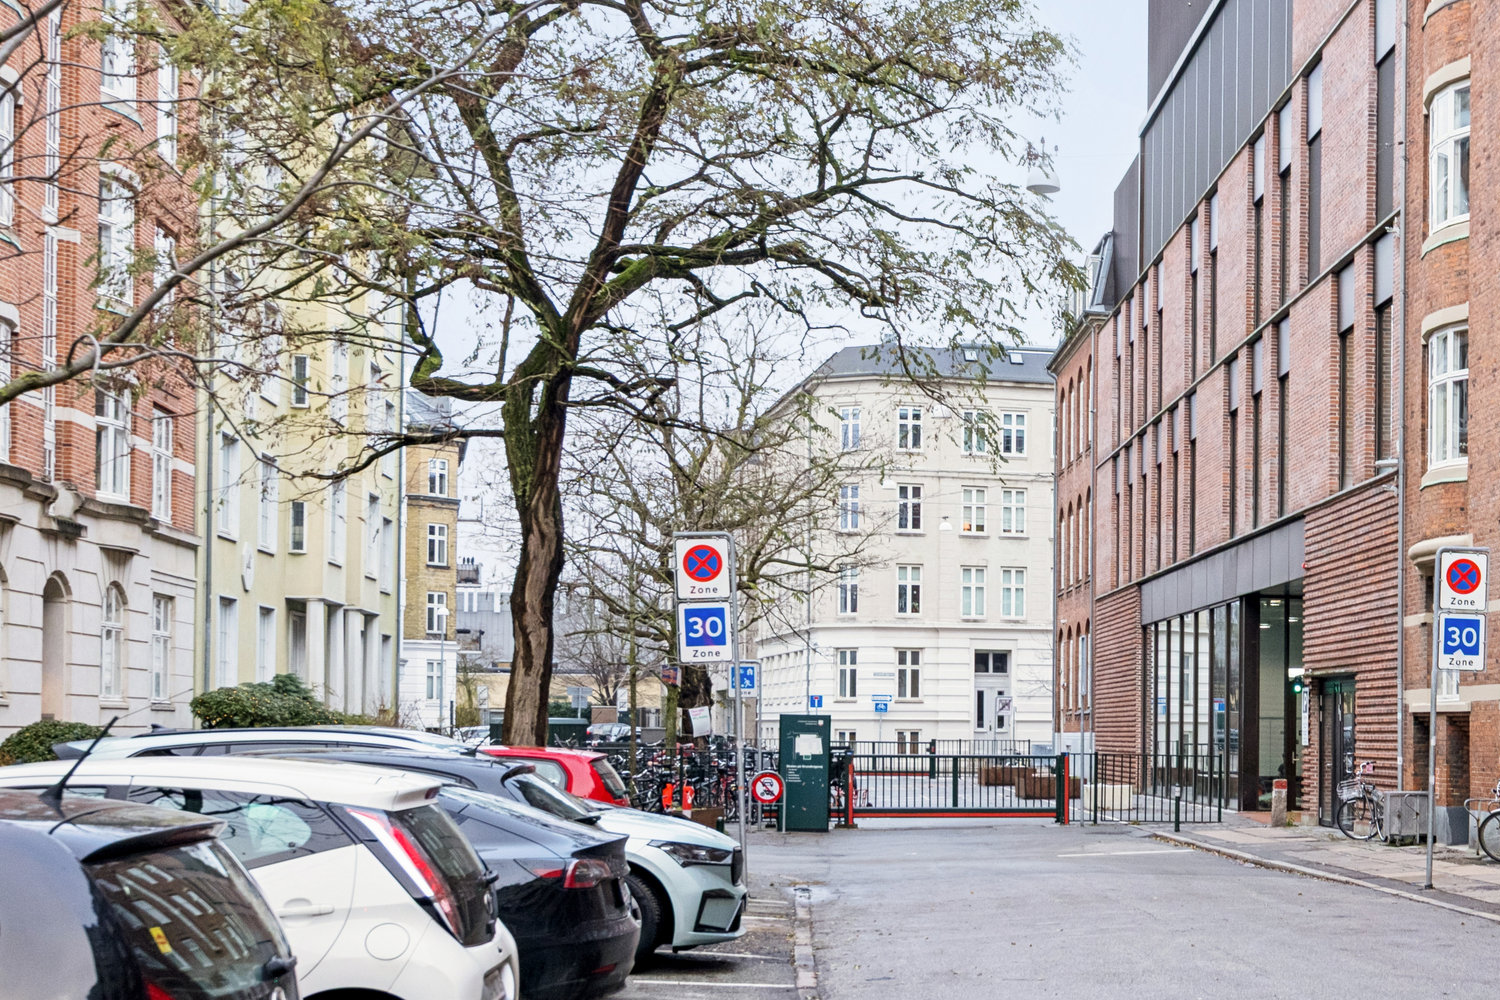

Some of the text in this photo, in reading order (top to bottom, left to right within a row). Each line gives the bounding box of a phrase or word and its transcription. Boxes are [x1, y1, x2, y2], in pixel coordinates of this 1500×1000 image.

[690, 586, 718, 594] Zone
[1450, 597, 1475, 606] Zone
[688, 616, 723, 638] 30
[1446, 626, 1477, 647] 30
[692, 649, 720, 658] Zone
[1449, 657, 1474, 666] Zone
